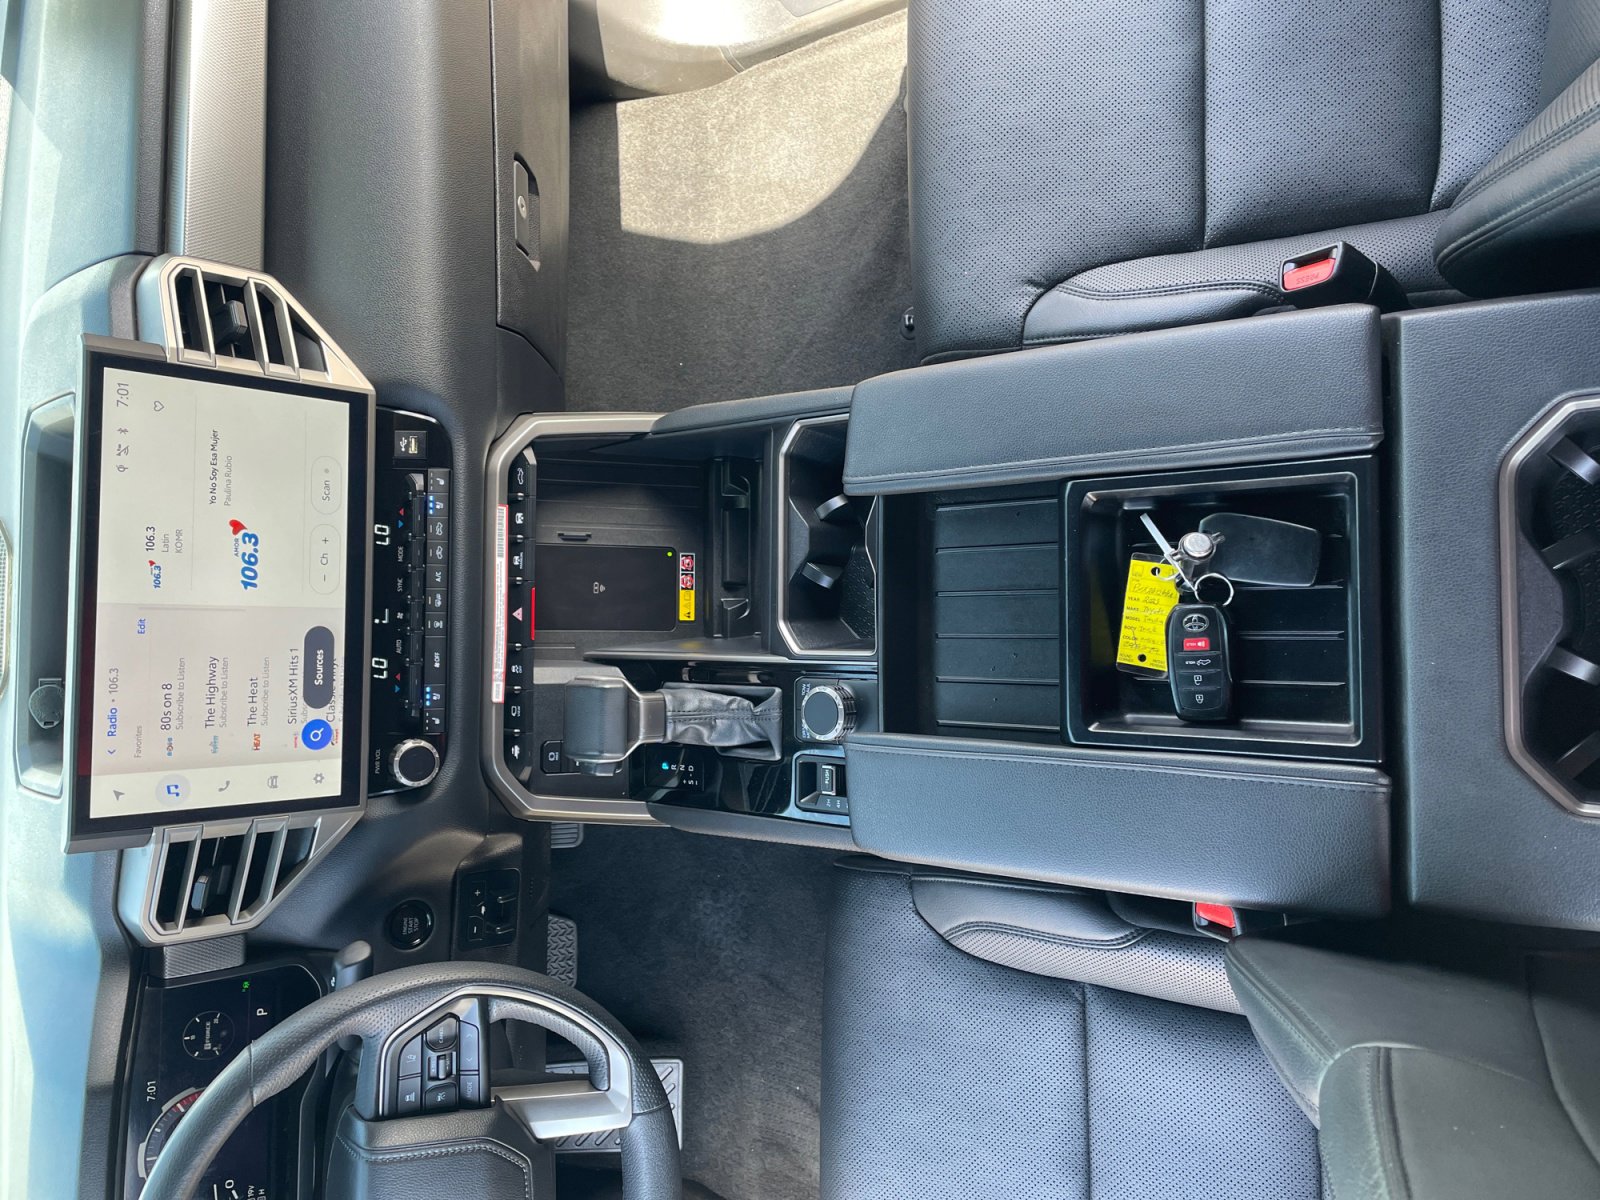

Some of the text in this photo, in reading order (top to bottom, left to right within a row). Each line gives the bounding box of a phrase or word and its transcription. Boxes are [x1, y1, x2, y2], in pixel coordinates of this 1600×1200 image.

[116, 382, 129, 408] 7:01
[209, 430, 220, 504] Yo No Soy Esa Mujer
[224, 455, 233, 506] Paulina Rubio
[322, 480, 331, 501] Scan
[146, 526, 155, 552] 106.3
[175, 529, 183, 553] KOMR
[241, 532, 259, 590] 106.3
[320, 553, 328, 565] Ch
[153, 565, 162, 589] 106.3
[138, 618, 146, 634] Edit
[262, 657, 270, 679] Listen
[289, 655, 299, 676] Hits
[314, 649, 324, 685] Sources
[205, 656, 220, 705] Highway
[219, 657, 229, 728] Subscribe to Listen
[107, 668, 119, 737] Radio 106.3
[164, 693, 172, 708] on
[176, 657, 185, 730] Subscribe to Listen
[247, 677, 258, 726] The Heat
[288, 678, 298, 724] SiriusXM
[205, 708, 216, 728] The
[261, 689, 269, 726] Subscribe
[161, 710, 172, 731] 80s
[134, 725, 143, 758] Favorites
[253, 733, 261, 750] HEAT
[661, 762, 669, 770] P
[256, 1008, 268, 1016] P
[147, 1081, 156, 1102] 7:01
